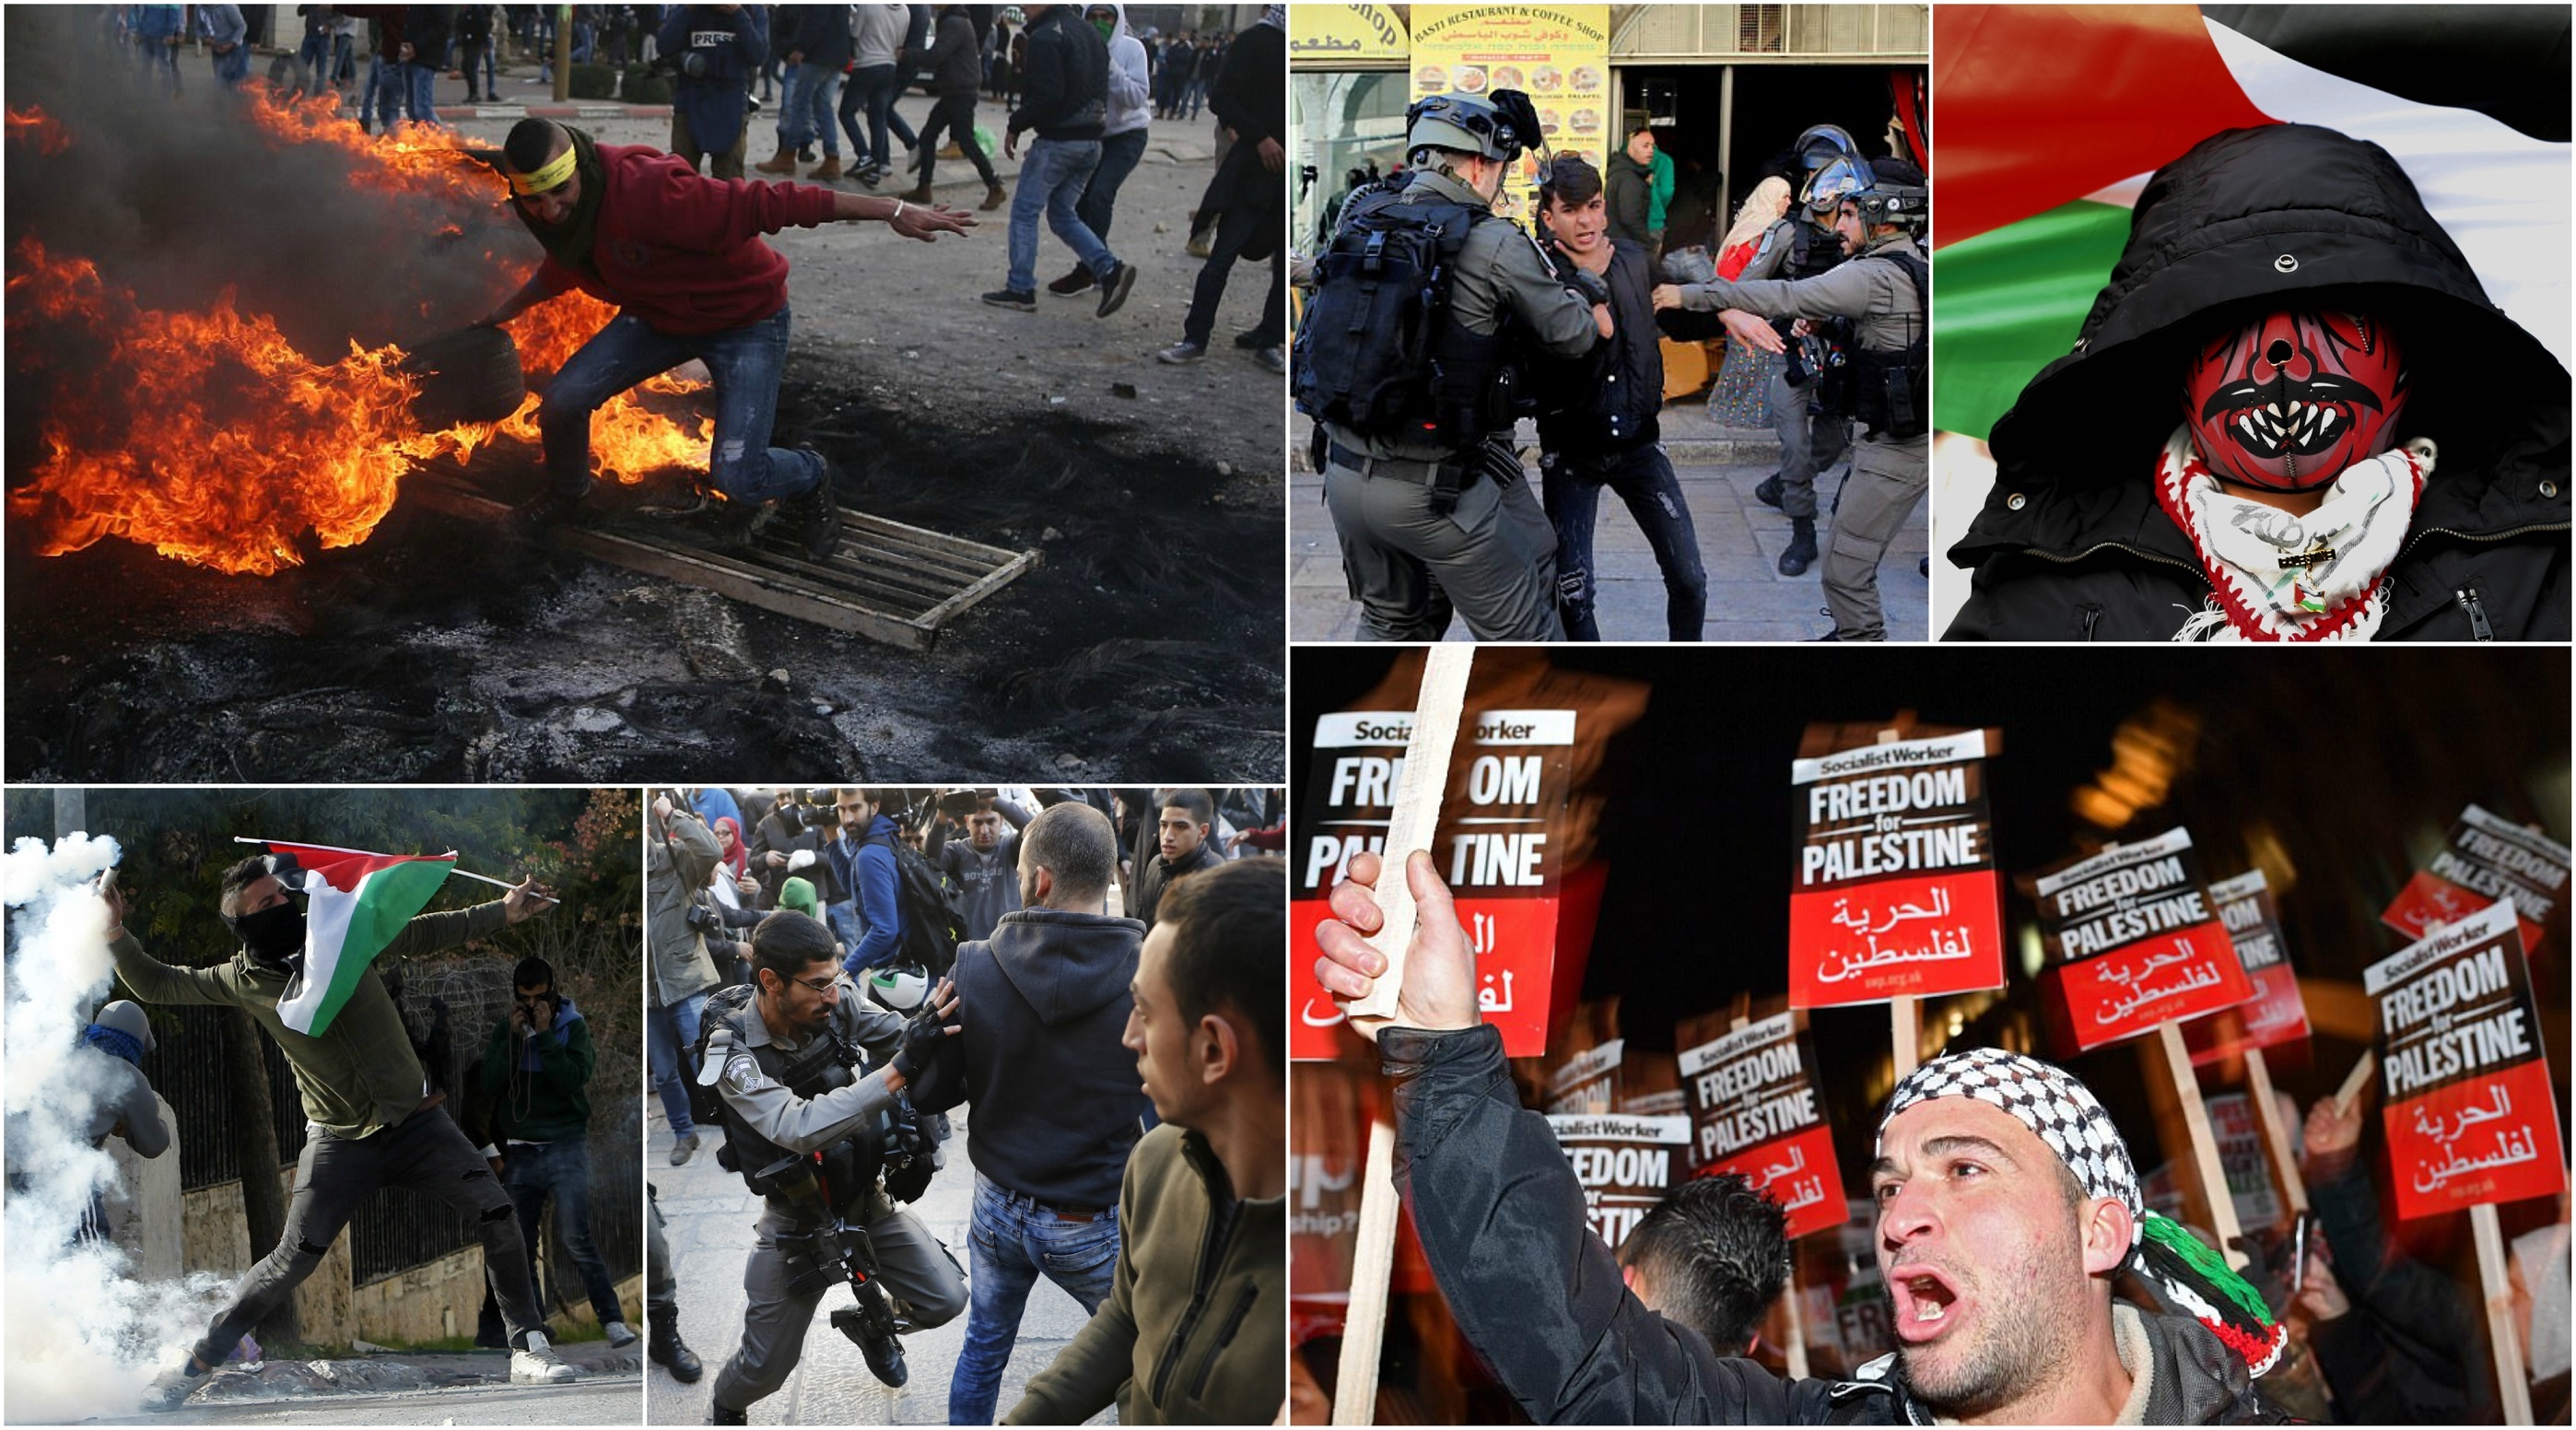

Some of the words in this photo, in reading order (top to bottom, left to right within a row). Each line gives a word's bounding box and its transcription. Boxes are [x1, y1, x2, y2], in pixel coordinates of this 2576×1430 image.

[1415, 20, 1446, 43] BASTI
[1447, 6, 1516, 26] RESTAURANT
[1520, 7, 1529, 16] &
[1532, 8, 1574, 27] COFFEE
[1576, 21, 1605, 41] SHOP
[1477, 721, 1536, 739] orker
[1821, 749, 1891, 775] Socialist
[1892, 744, 1955, 764] Worker
[1809, 767, 1966, 825] FREEDOM
[1874, 813, 1903, 833] for
[1802, 824, 1981, 885] PALESTINE
[2457, 828, 2568, 890] FREEDOM
[1831, 886, 1950, 935] الحرية
[2056, 855, 2185, 917] FREEDOM
[1817, 926, 1972, 982] لفلسطين
[2060, 891, 2210, 960] PALESTINE
[2434, 922, 2488, 954] Worker
[2096, 938, 2195, 985] الحرية
[2381, 944, 2510, 1035] FREEDOM
[2095, 961, 2221, 1025] لفلسطين
[1697, 1042, 1802, 1109] FREEDOM
[2384, 1007, 2531, 1096] PALESTINE
[1553, 1120, 1599, 1136] cialist
[1602, 1120, 1663, 1138] Worker
[1701, 1088, 1819, 1161] PALESTINE
[2414, 1084, 2512, 1143] الحرية
[2414, 1125, 2537, 1193] لفلسطين
